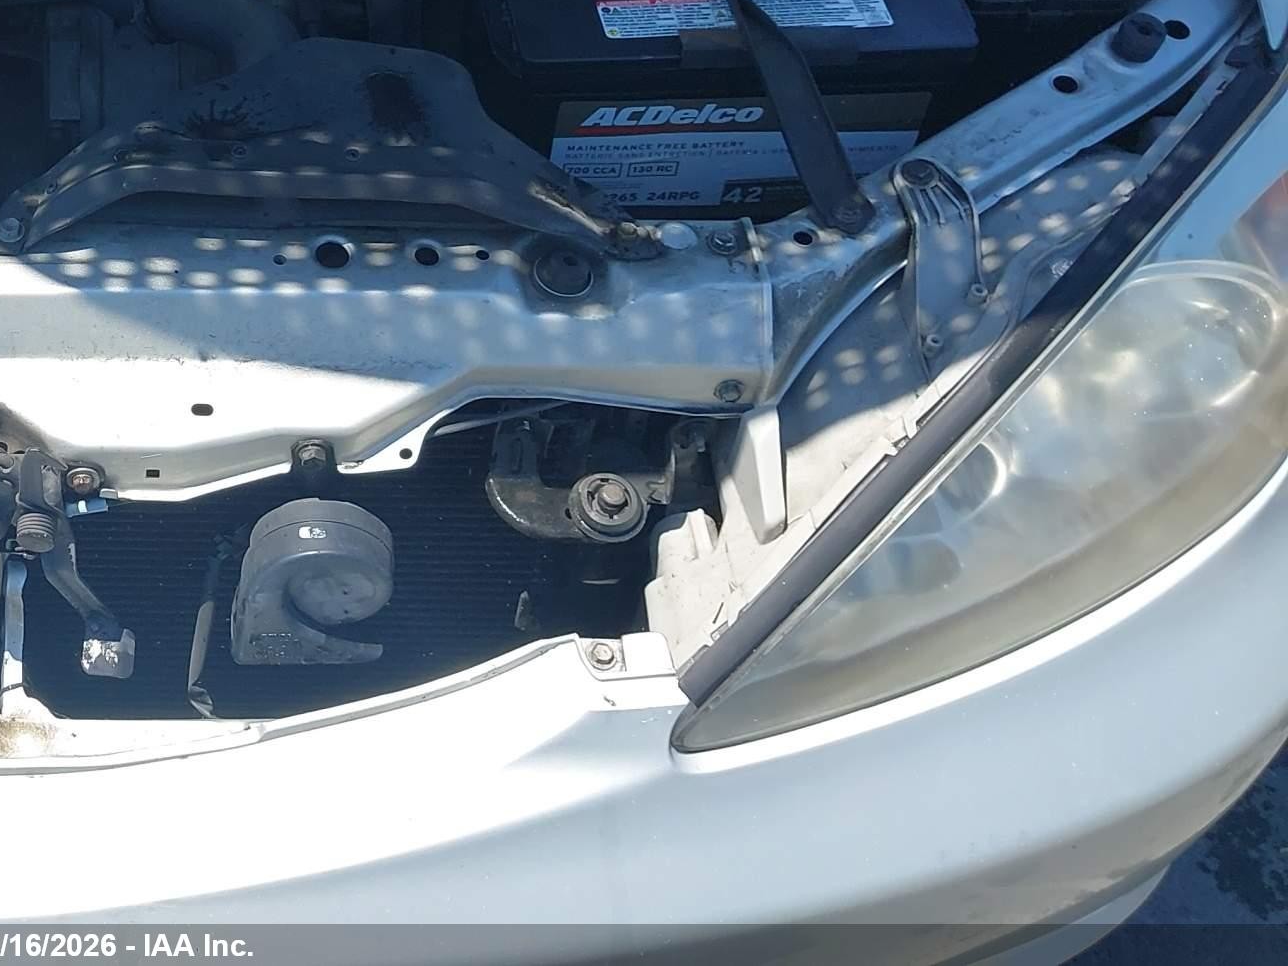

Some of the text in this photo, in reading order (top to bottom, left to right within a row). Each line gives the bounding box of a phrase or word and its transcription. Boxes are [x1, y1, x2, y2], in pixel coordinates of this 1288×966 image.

[580, 103, 764, 127] ACDelco
[566, 141, 745, 152] MAINTENANCE FREE BATTERY
[567, 166, 617, 175] 700 CCA
[632, 165, 651, 173] 130
[647, 191, 700, 201] 24RPG
[722, 186, 762, 203] 42
